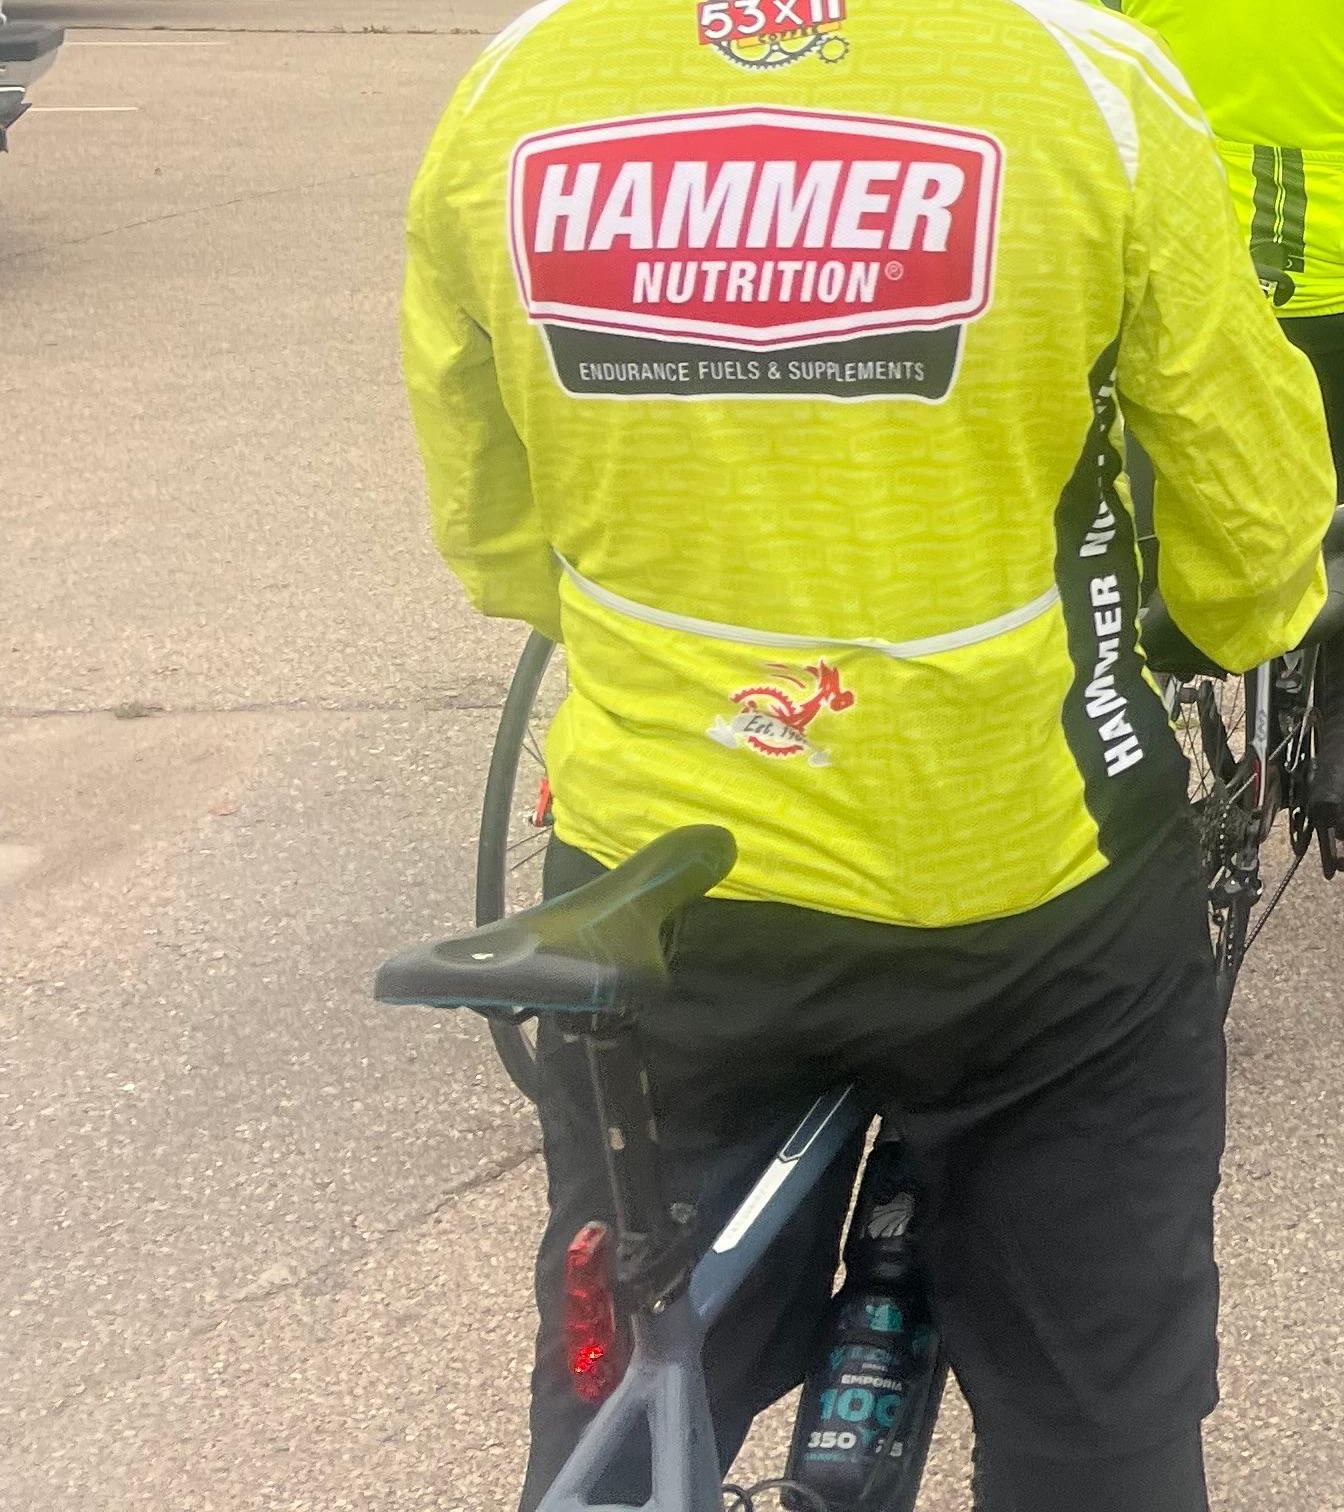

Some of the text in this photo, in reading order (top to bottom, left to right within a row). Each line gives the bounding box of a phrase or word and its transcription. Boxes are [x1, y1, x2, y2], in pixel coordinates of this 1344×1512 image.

[534, 160, 966, 254] HAMMER
[578, 361, 925, 382] ENDURANCE FUELS & SUPPLEMENTS
[1084, 574, 1144, 778] HAMMER
